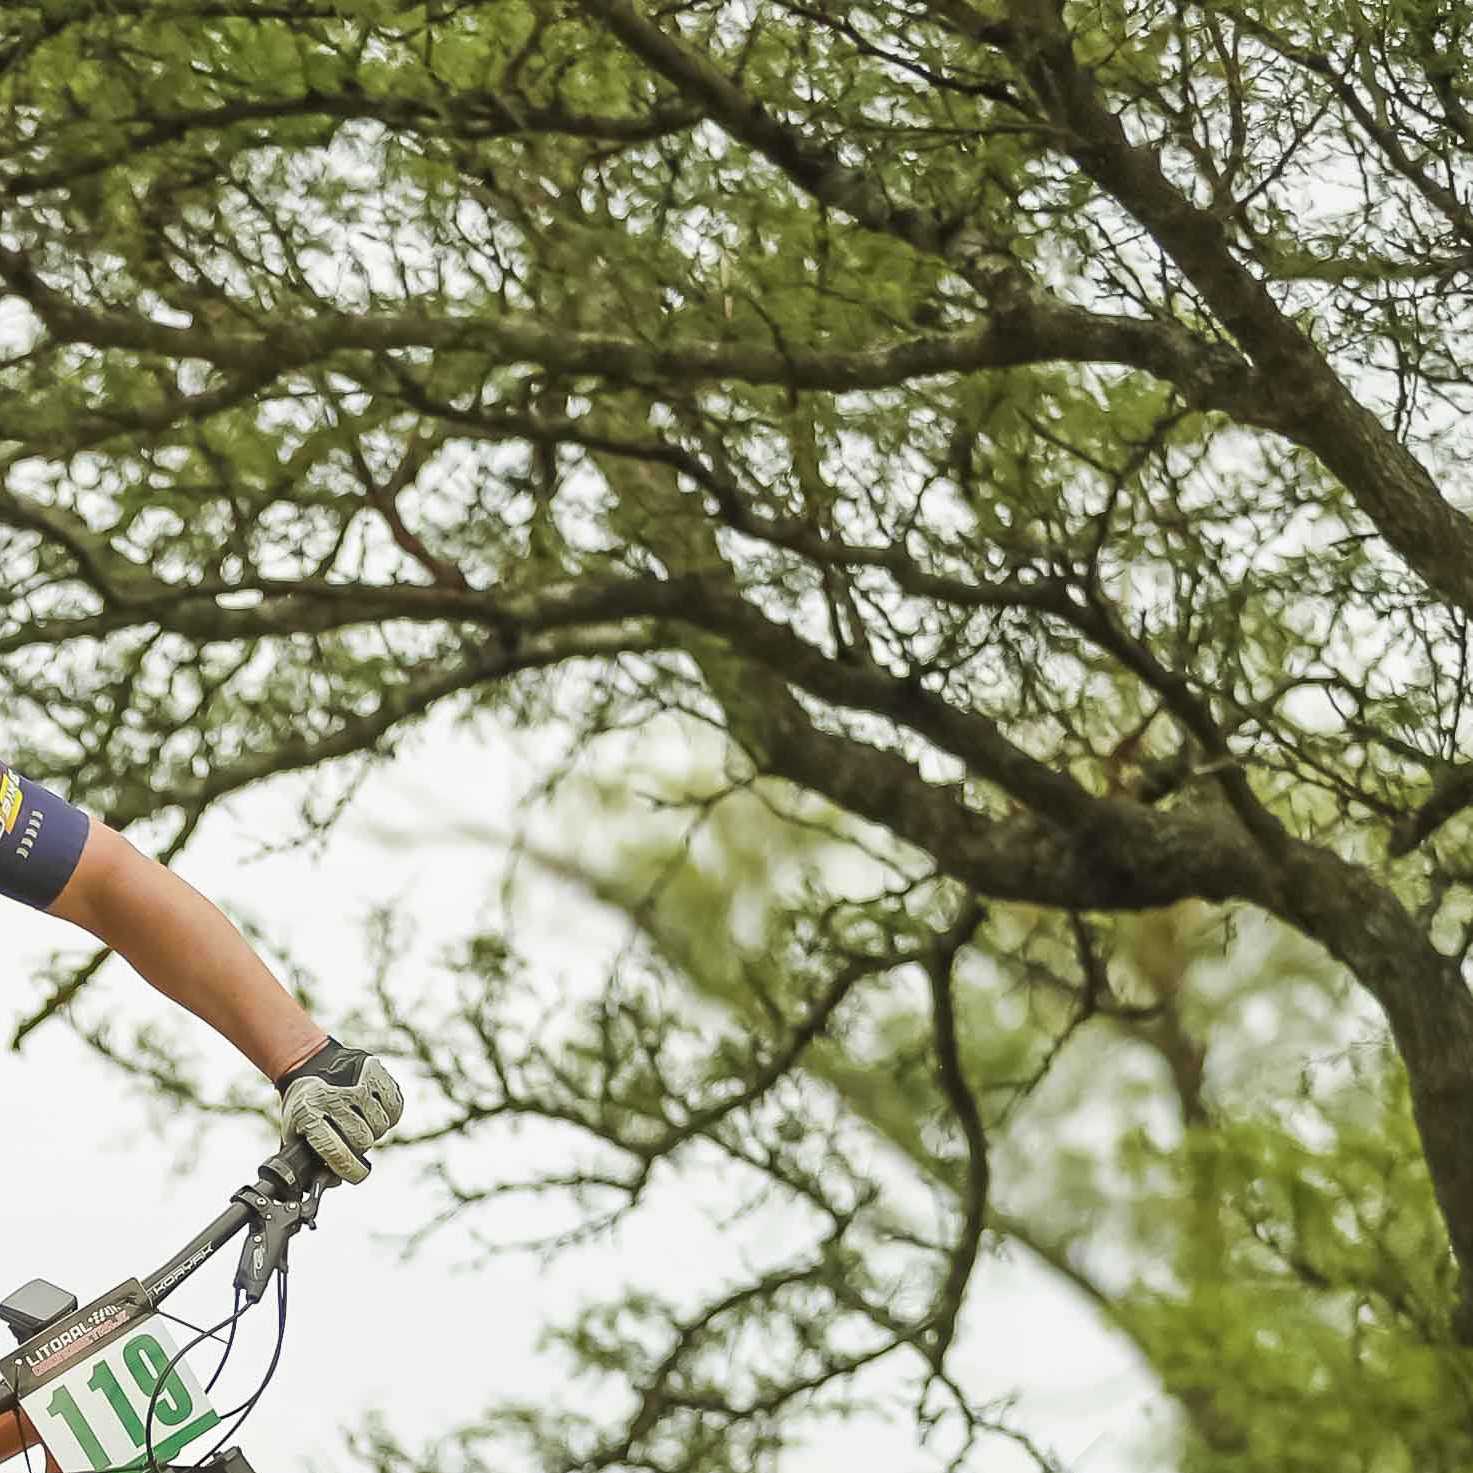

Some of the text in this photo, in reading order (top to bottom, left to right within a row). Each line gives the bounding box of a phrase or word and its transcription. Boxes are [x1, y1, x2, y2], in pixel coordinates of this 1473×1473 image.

[153, 1241, 214, 1295] KORYAK
[25, 1322, 93, 1367] LITORAL
[46, 1333, 193, 1472] 119
